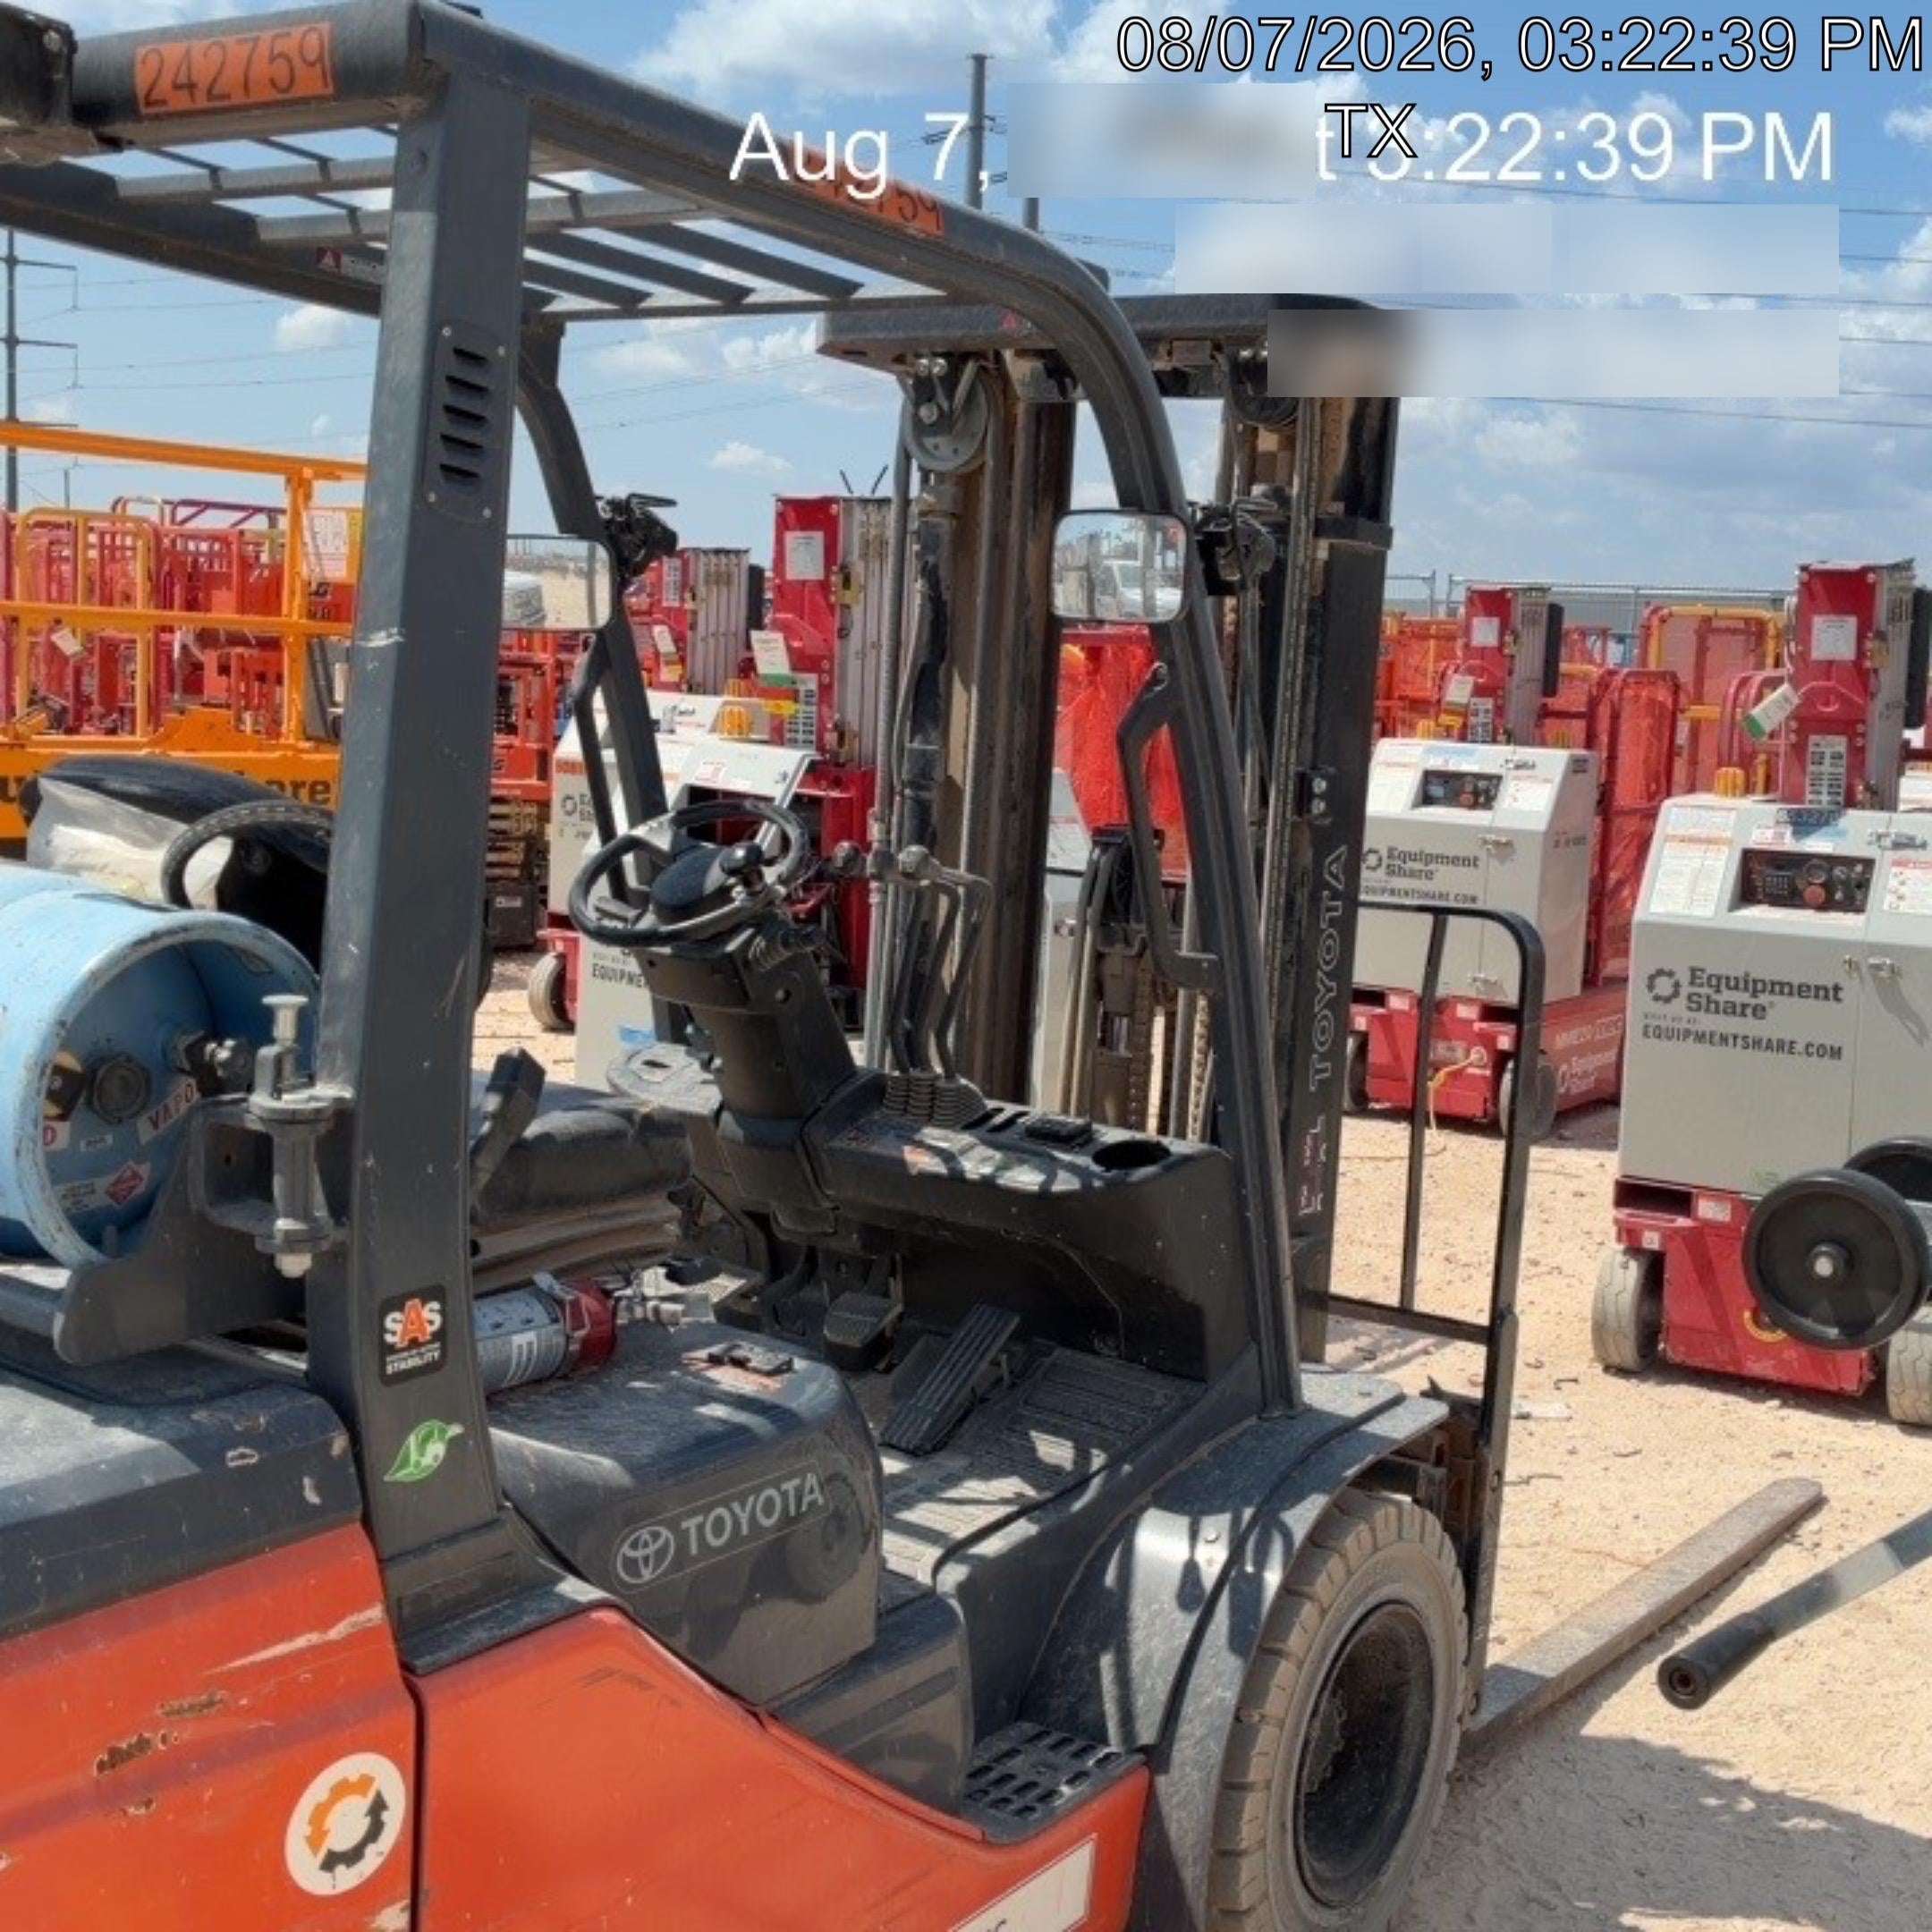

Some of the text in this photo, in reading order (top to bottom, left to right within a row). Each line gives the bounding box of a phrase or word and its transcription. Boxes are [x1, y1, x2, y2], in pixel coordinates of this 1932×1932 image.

[141, 26, 329, 107] 242759
[1309, 844, 1348, 1093] TOYOTA
[1687, 964, 1844, 1004] Equipment
[1686, 991, 1768, 1021] Share
[1642, 1023, 1843, 1061] EQUIPMENTSHARE.COM
[382, 1297, 442, 1349] SAS
[680, 1472, 825, 1557] TOYOTA
